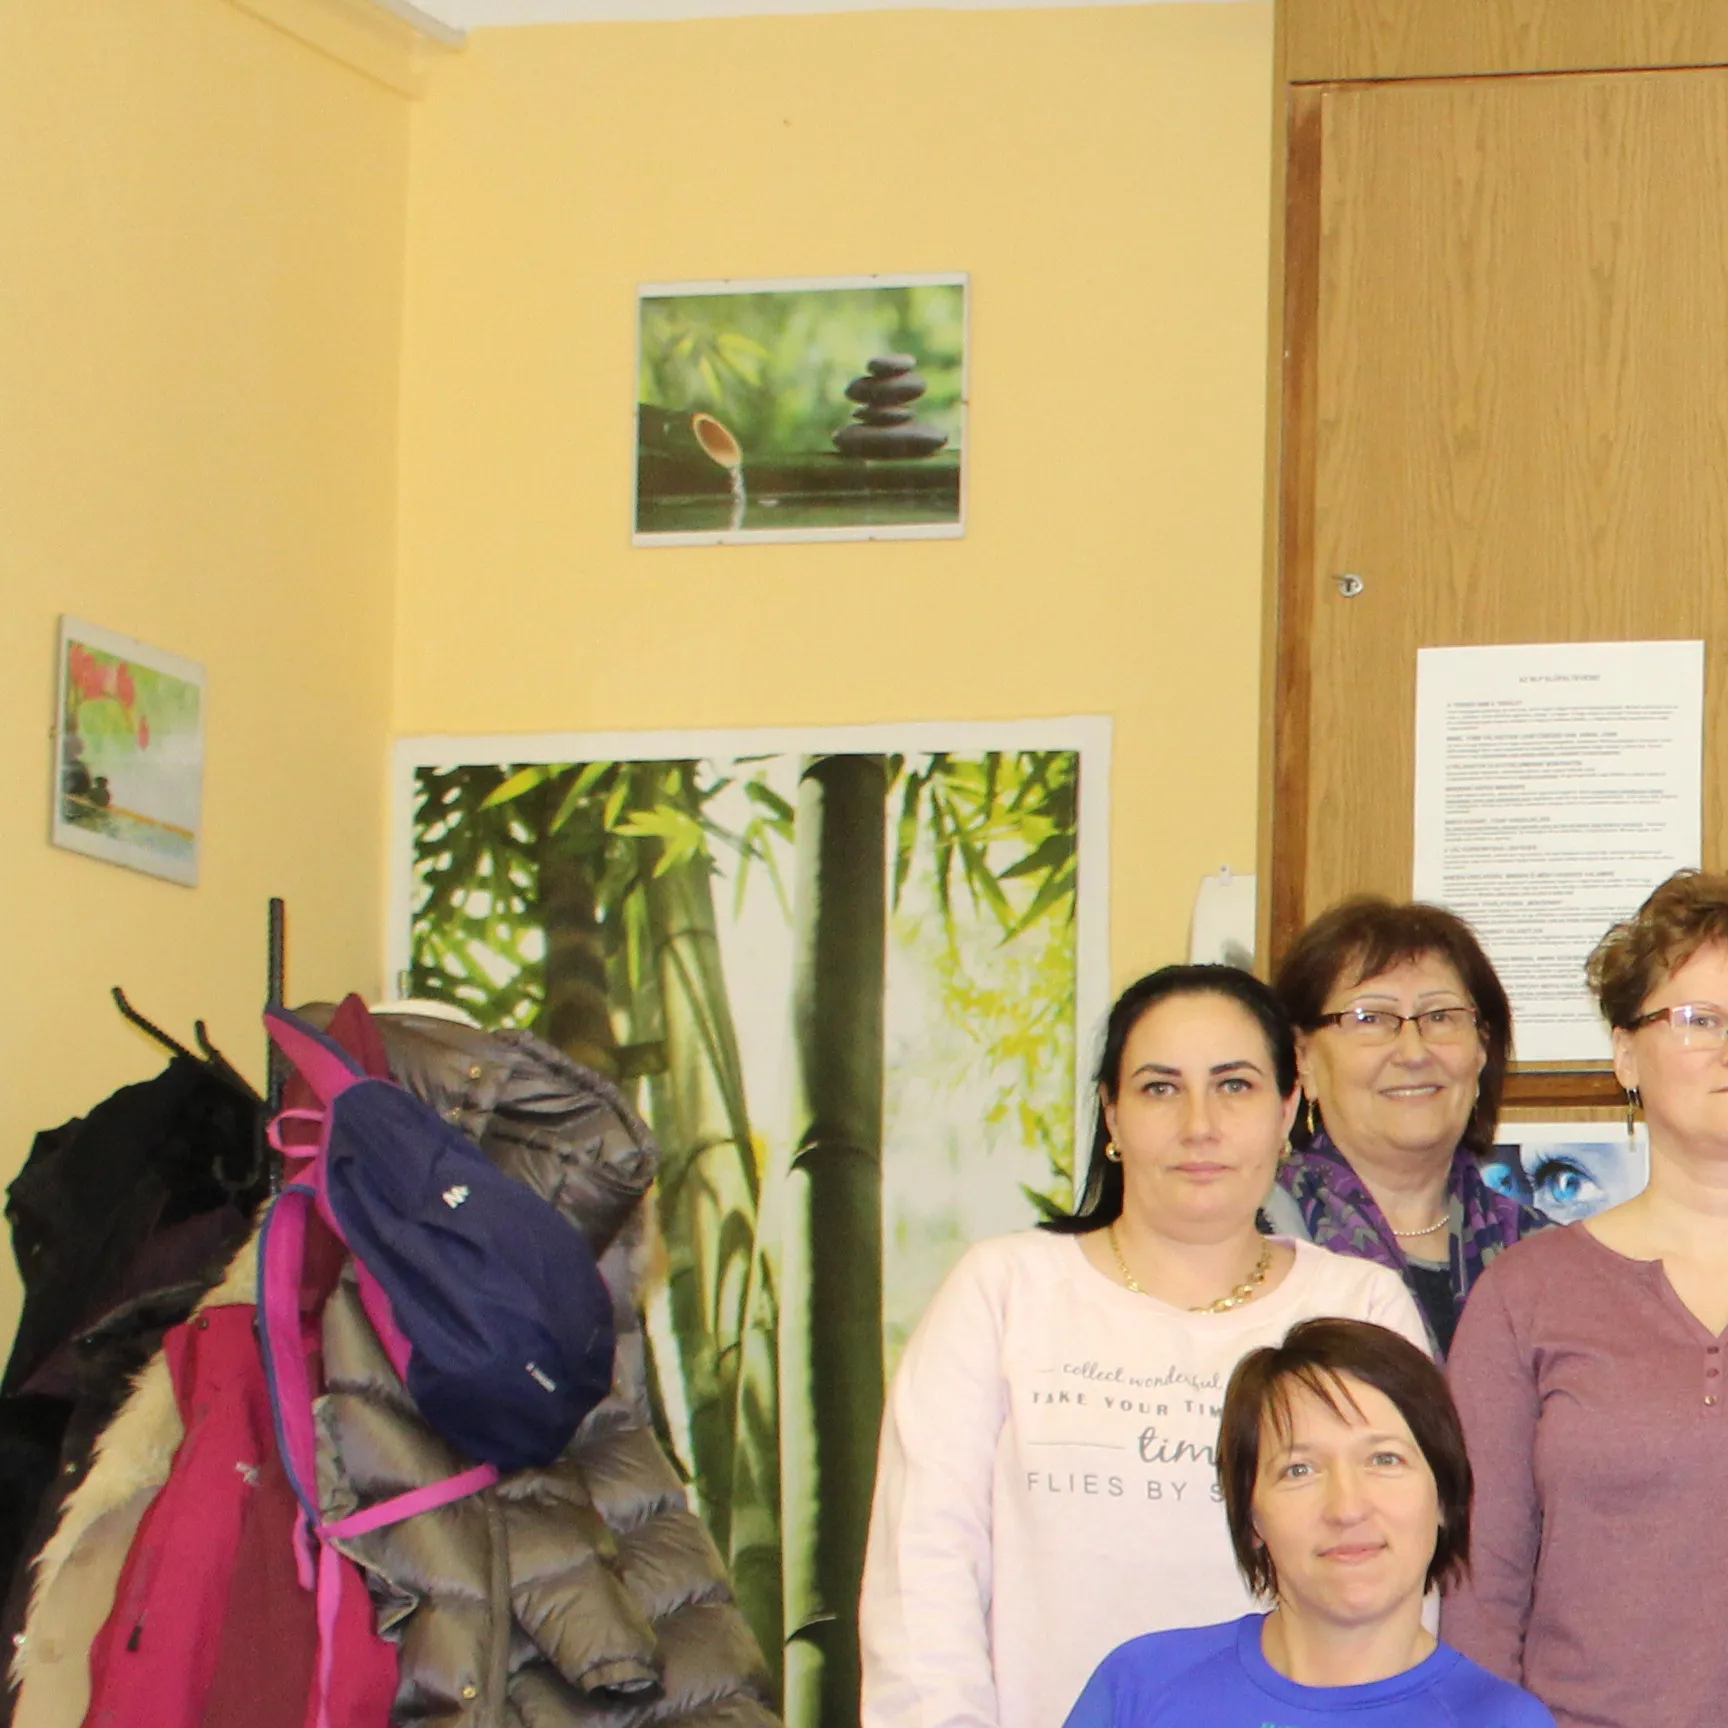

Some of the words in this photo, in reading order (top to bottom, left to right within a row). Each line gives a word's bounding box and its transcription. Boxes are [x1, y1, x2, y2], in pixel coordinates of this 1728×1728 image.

[1063, 1361, 1124, 1383] collect
[1128, 1365, 1223, 1392] wonderful
[1031, 1390, 1088, 1406] TAKE
[1104, 1396, 1169, 1416] YOUR
[1184, 1400, 1224, 1419] TIM
[1138, 1426, 1221, 1467] tim
[1027, 1472, 1124, 1497] FLIES
[1147, 1481, 1188, 1501] BY
